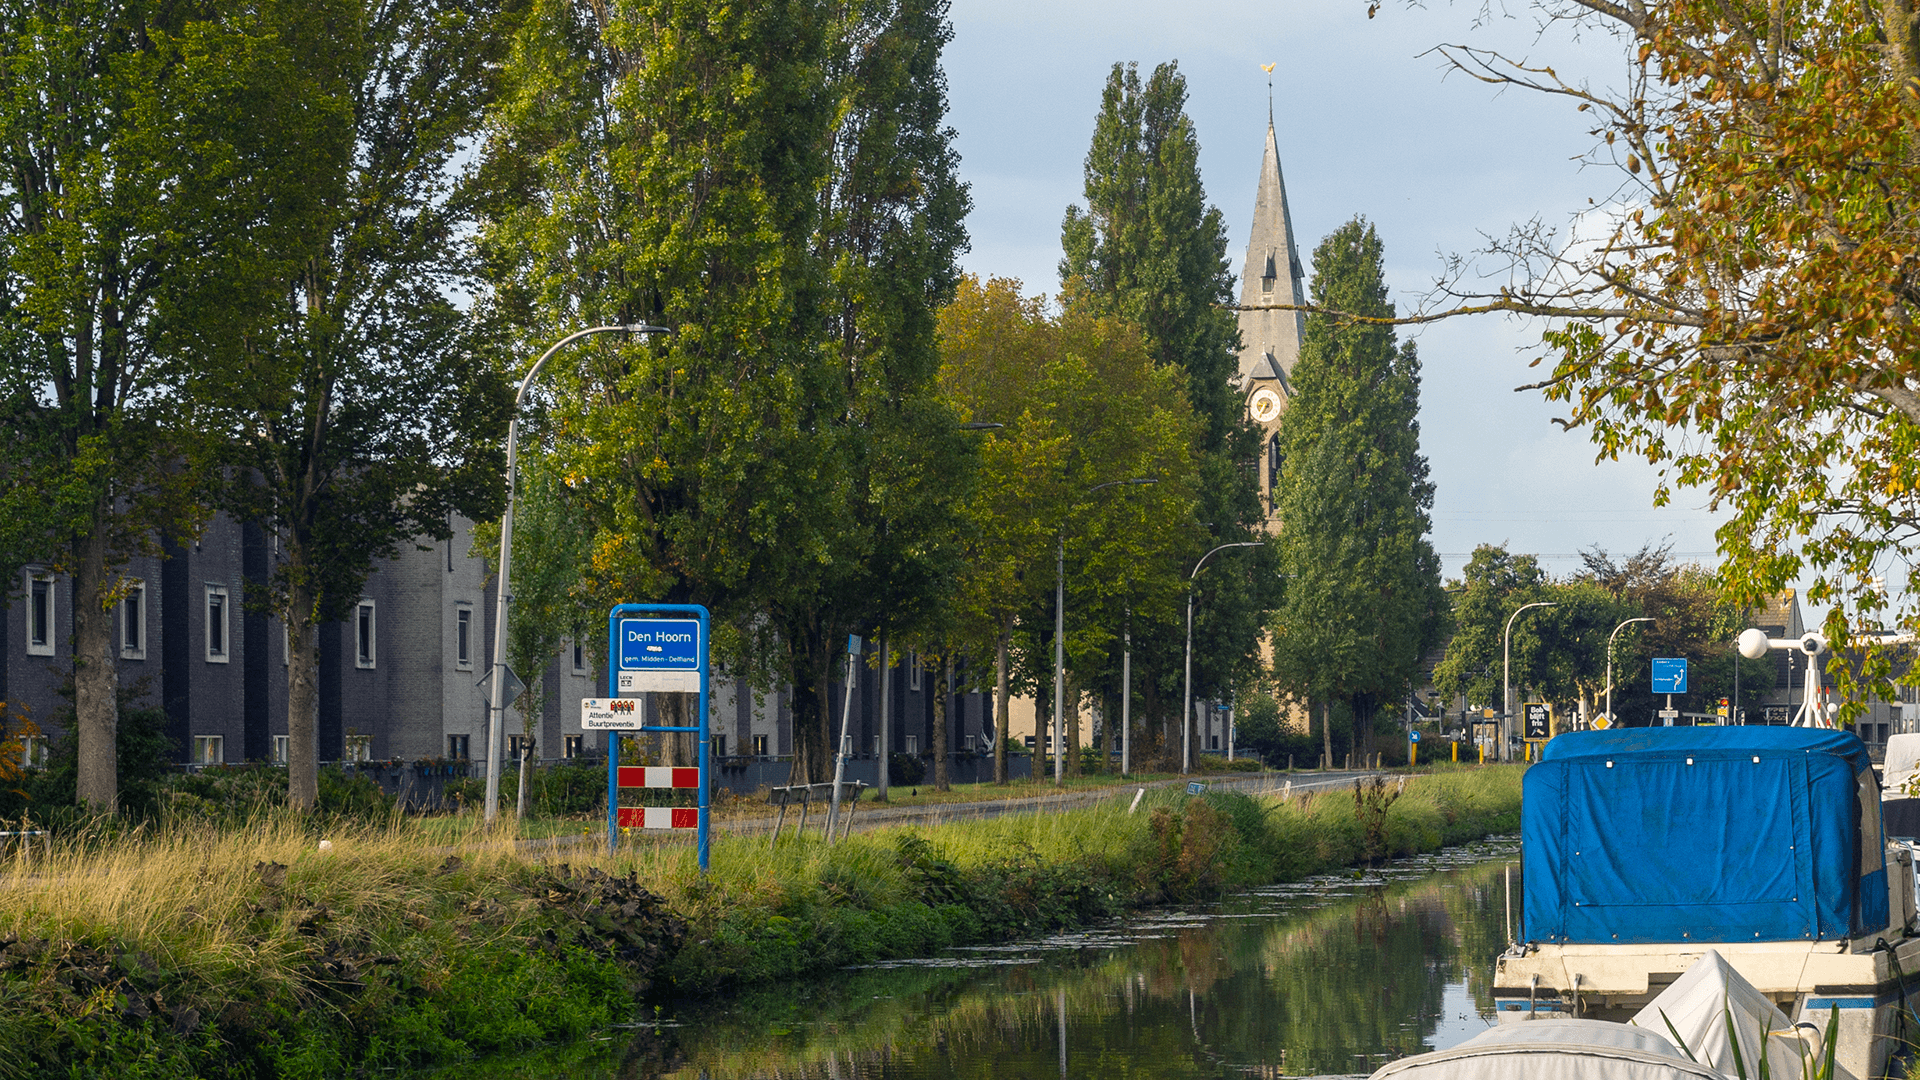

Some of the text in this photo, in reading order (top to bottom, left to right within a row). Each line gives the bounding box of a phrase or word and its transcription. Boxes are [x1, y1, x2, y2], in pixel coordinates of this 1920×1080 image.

[628, 630, 691, 642] Den Hoorn
[588, 720, 635, 728] Buurtpreventie
